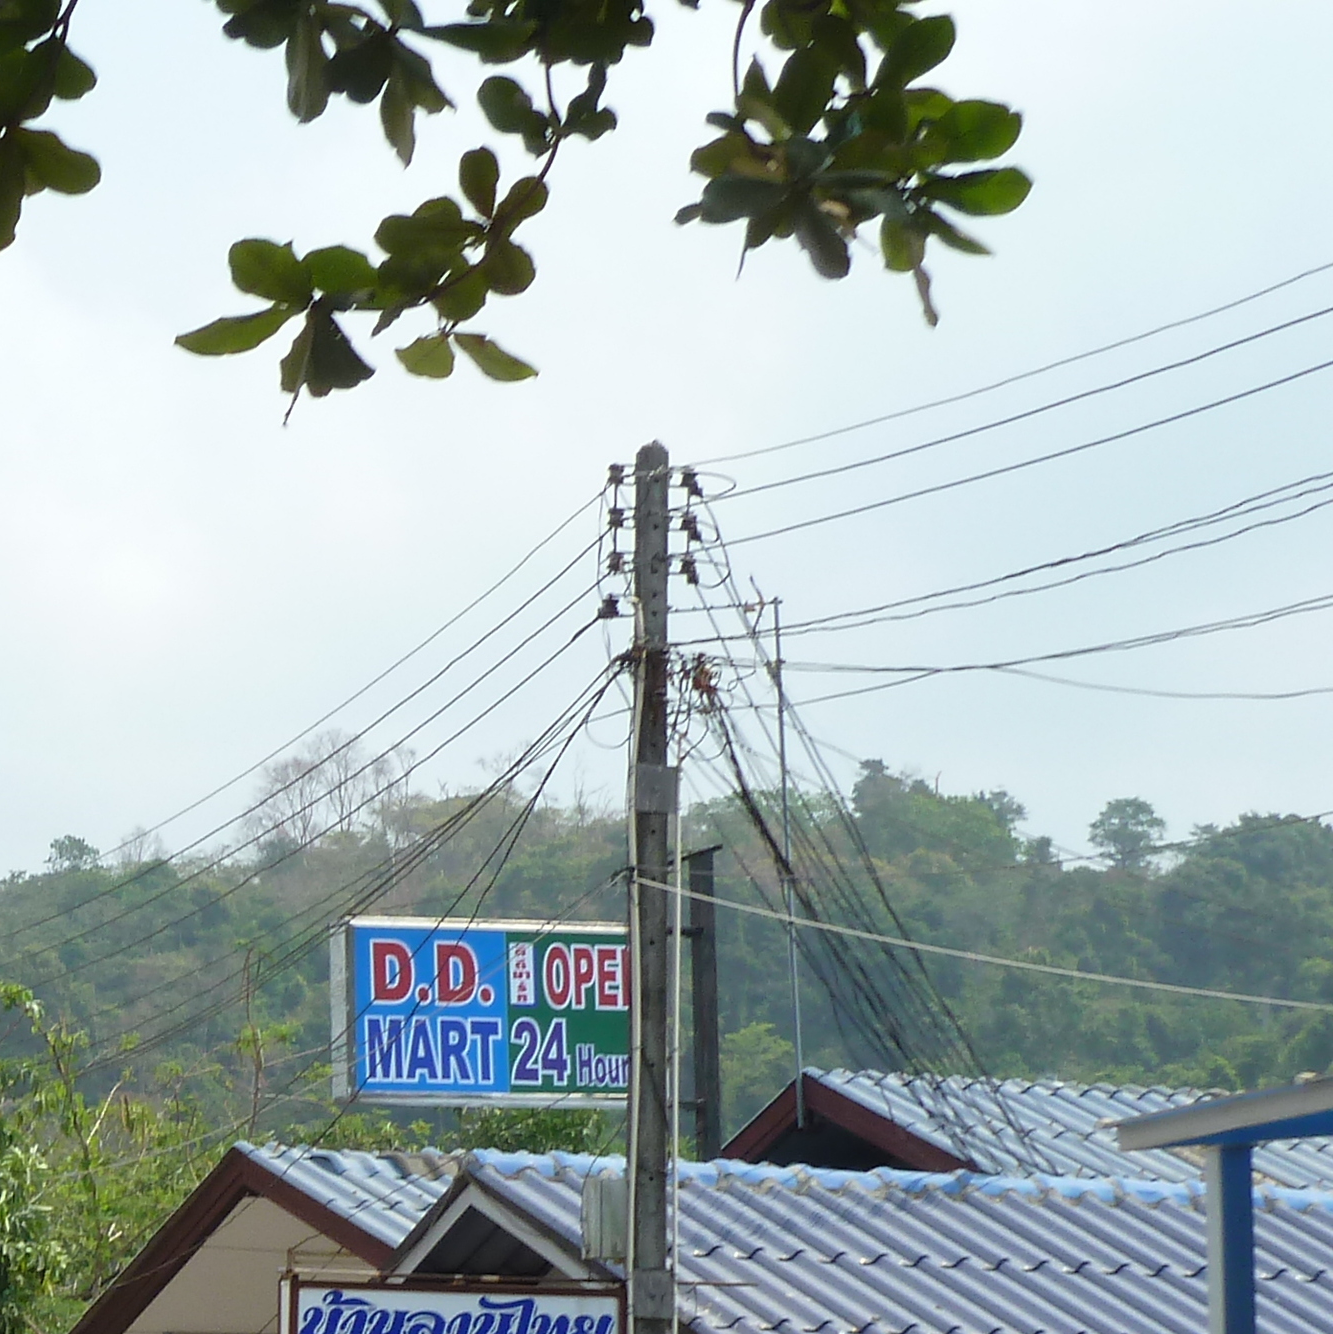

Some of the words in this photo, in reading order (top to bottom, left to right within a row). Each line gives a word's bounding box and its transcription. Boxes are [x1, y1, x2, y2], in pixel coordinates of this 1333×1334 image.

[369, 938, 495, 1006] D.D.
[364, 1014, 503, 1085] MART
[510, 1017, 571, 1086] 24
[576, 1044, 631, 1088] Hour
